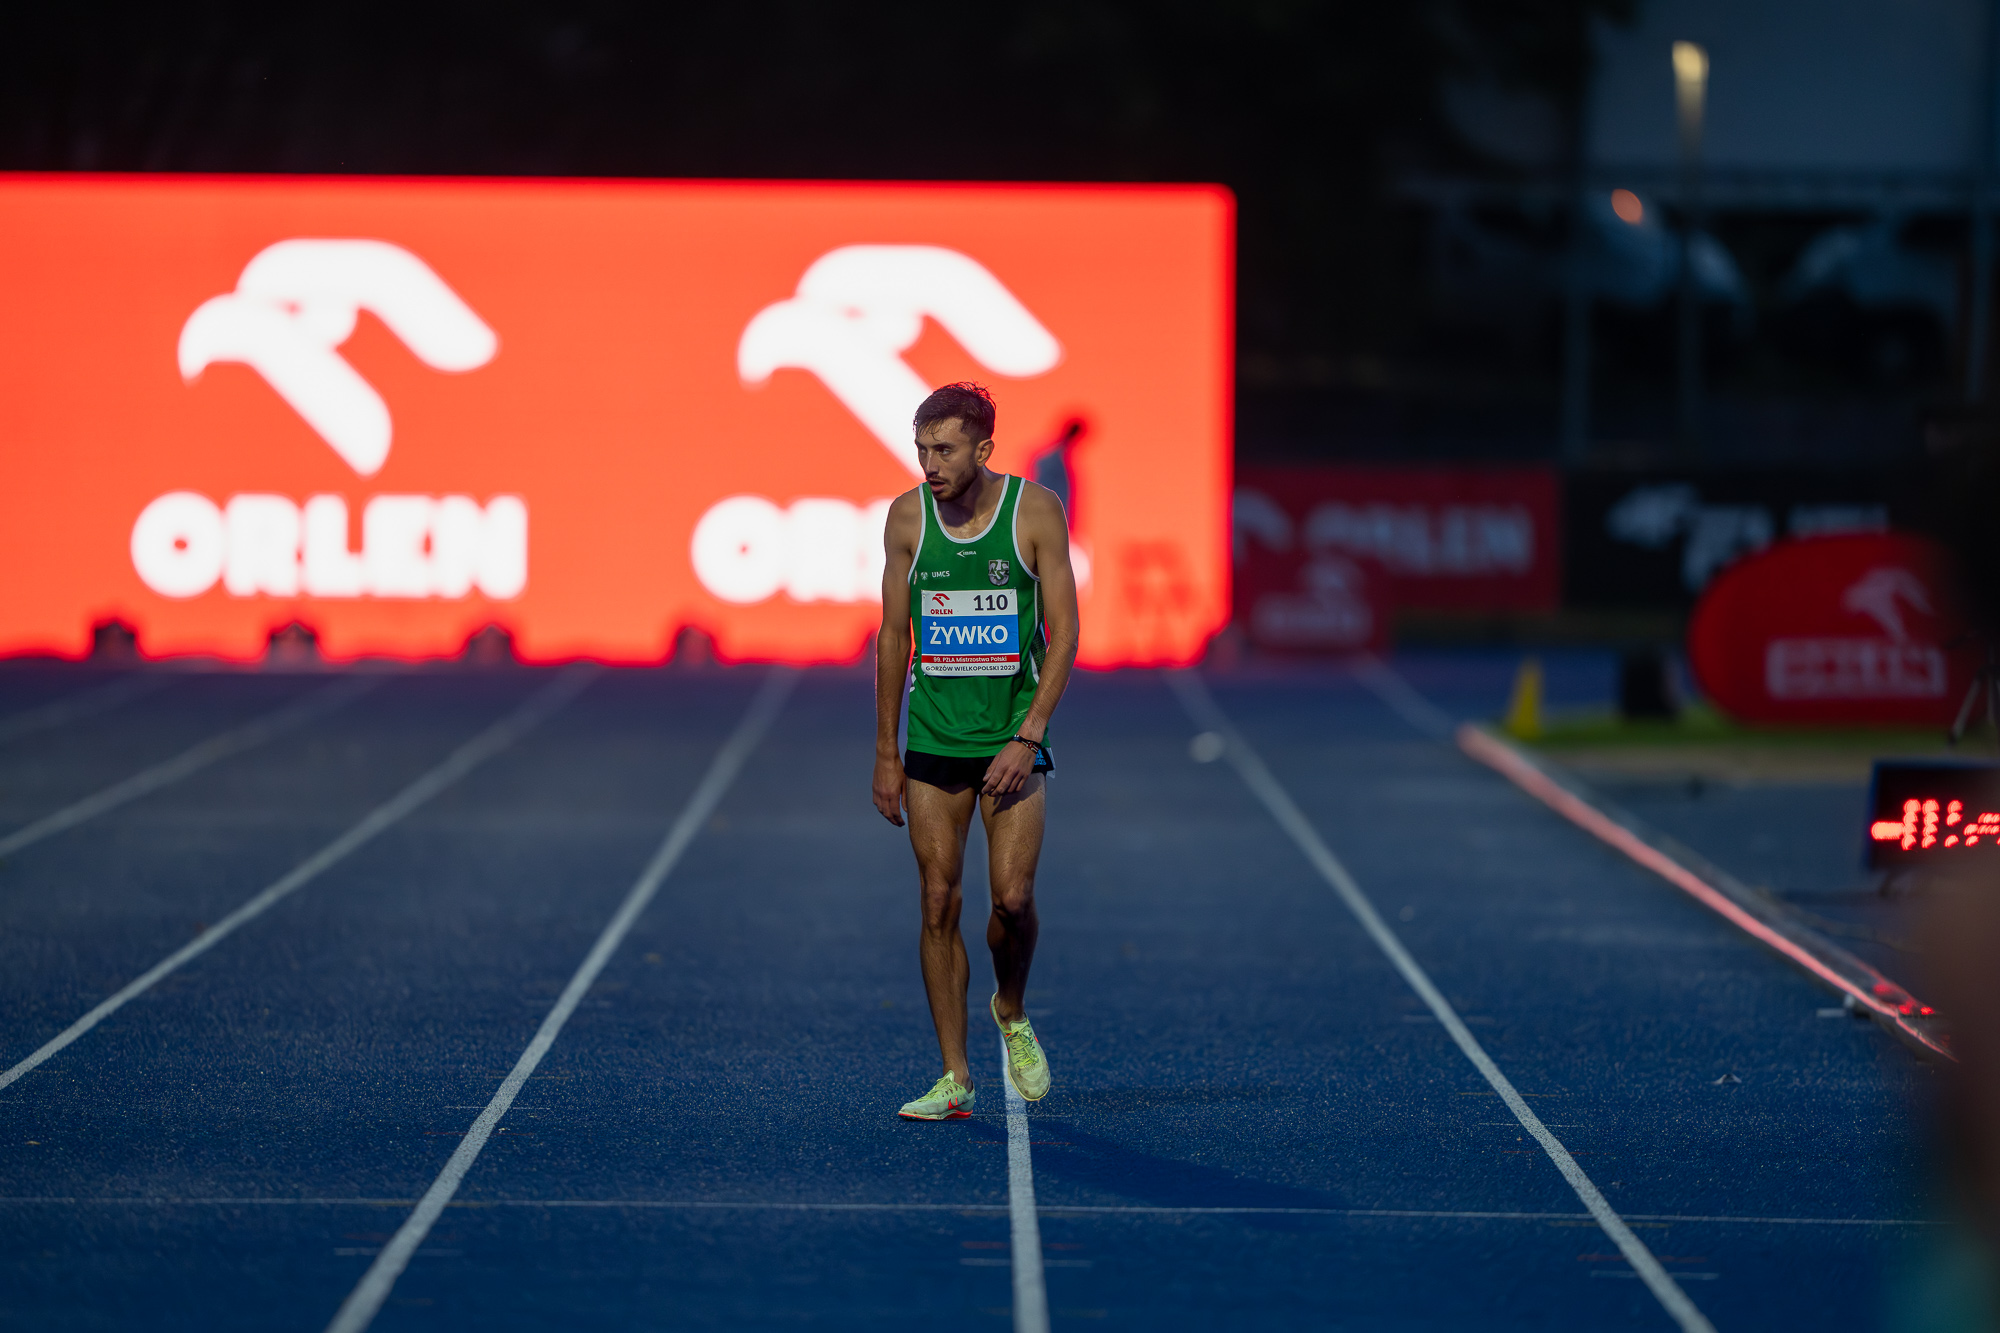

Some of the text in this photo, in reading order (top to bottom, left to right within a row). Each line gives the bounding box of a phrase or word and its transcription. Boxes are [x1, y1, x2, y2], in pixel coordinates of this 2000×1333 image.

[131, 490, 528, 599] ORLEN
[931, 570, 951, 578] UMCS
[973, 594, 1009, 611] 110
[929, 621, 1009, 645] ŻYWKO
